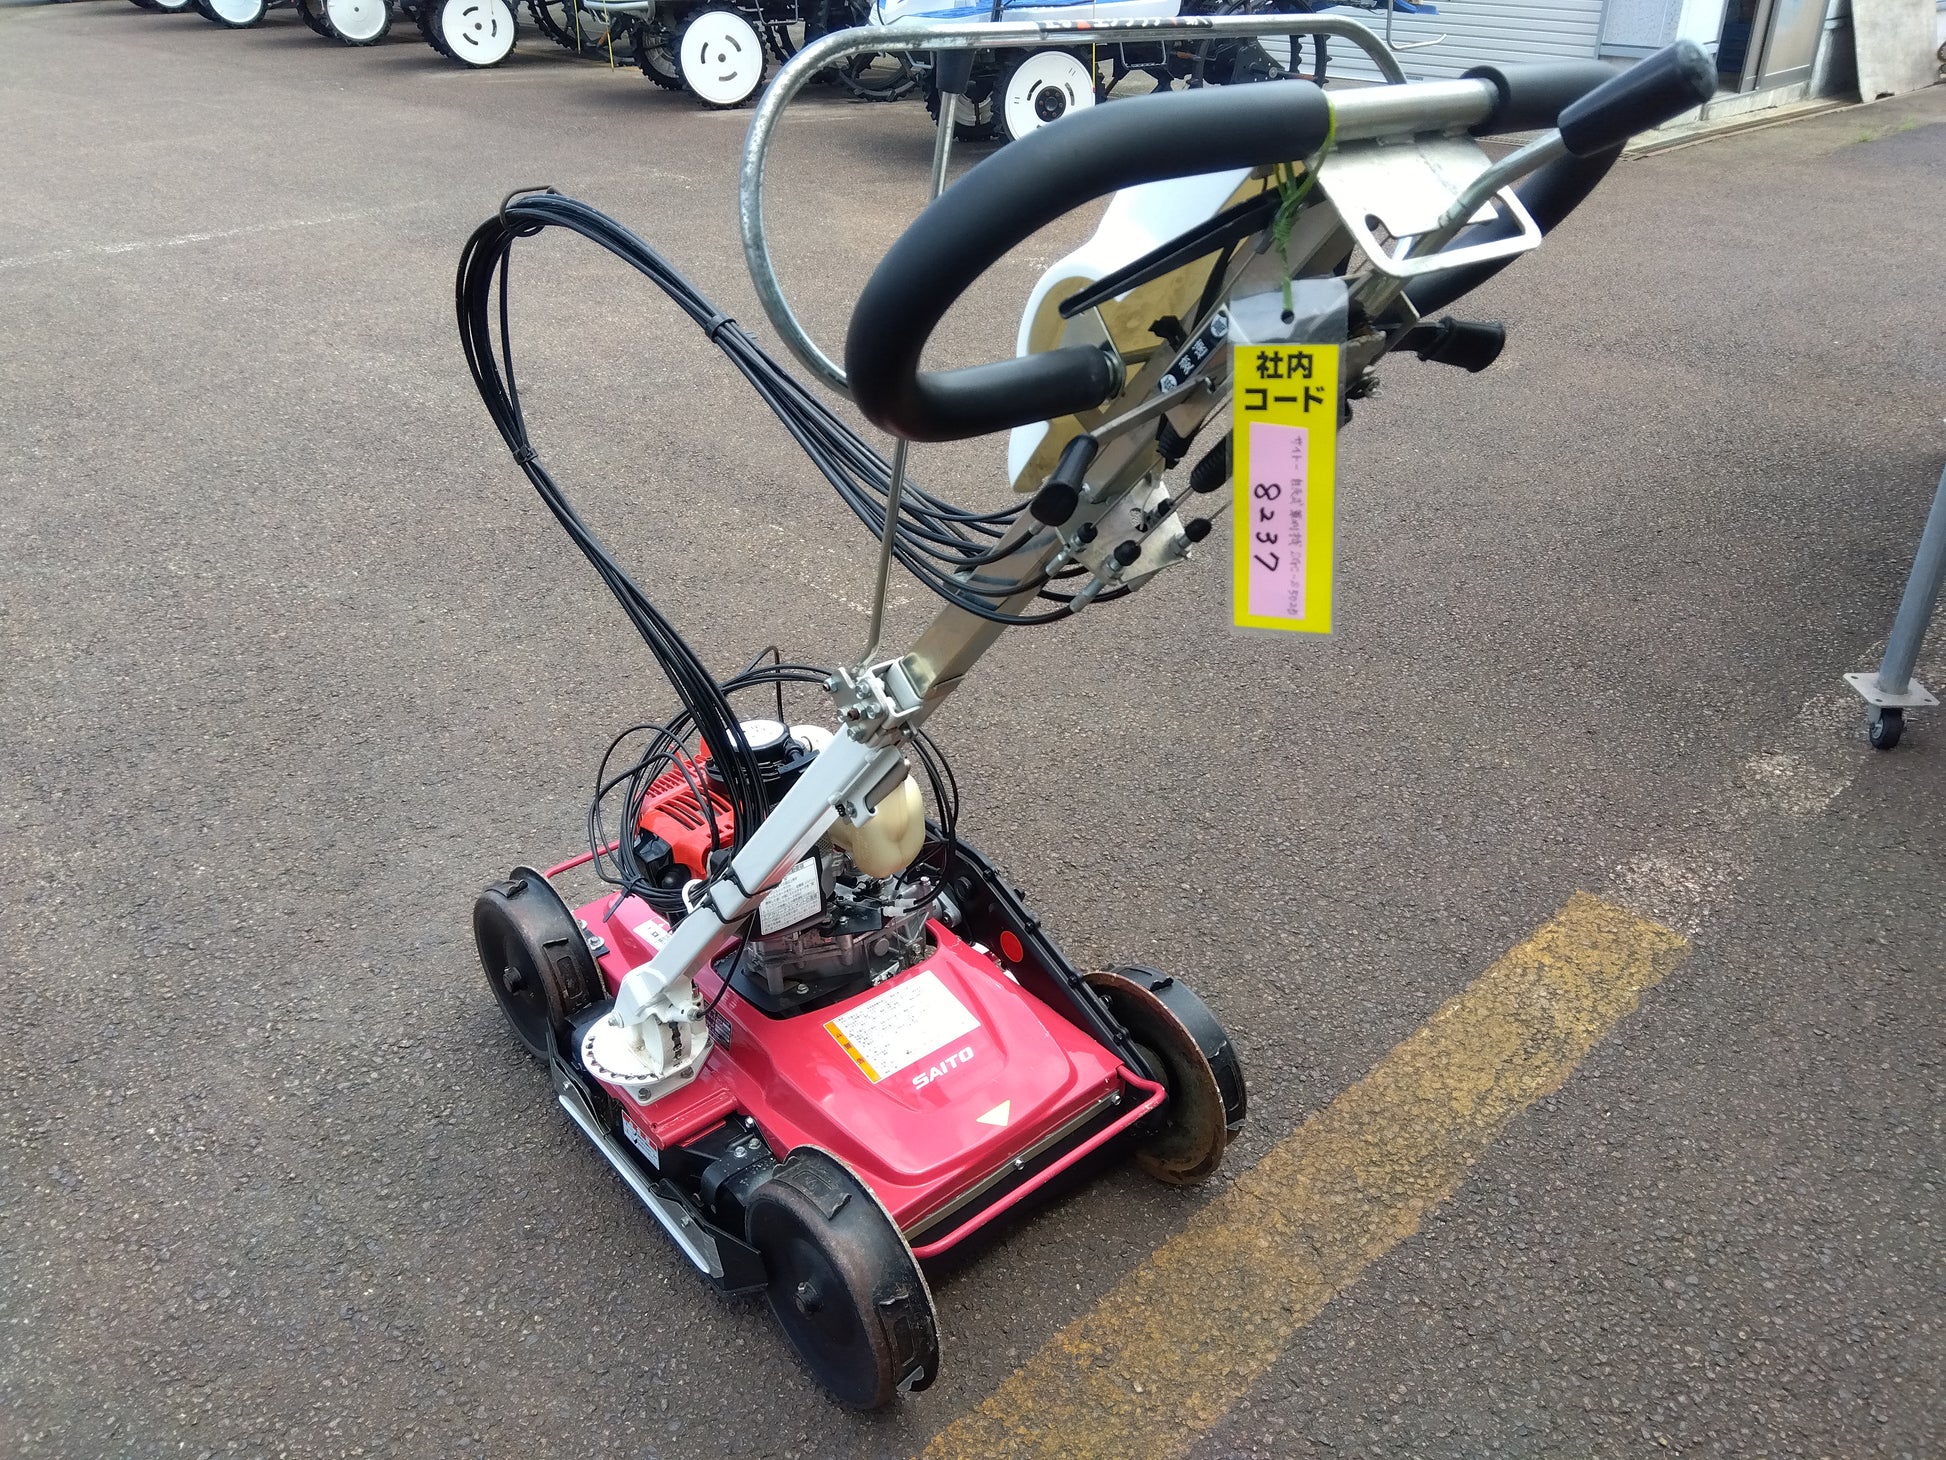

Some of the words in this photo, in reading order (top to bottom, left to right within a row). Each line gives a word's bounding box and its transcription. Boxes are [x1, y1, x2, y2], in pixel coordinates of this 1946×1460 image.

[1256, 351, 1313, 379] 社内
[1245, 386, 1325, 413] コード
[1253, 482, 1282, 573] 8237
[911, 1046, 975, 1091] SAITO
